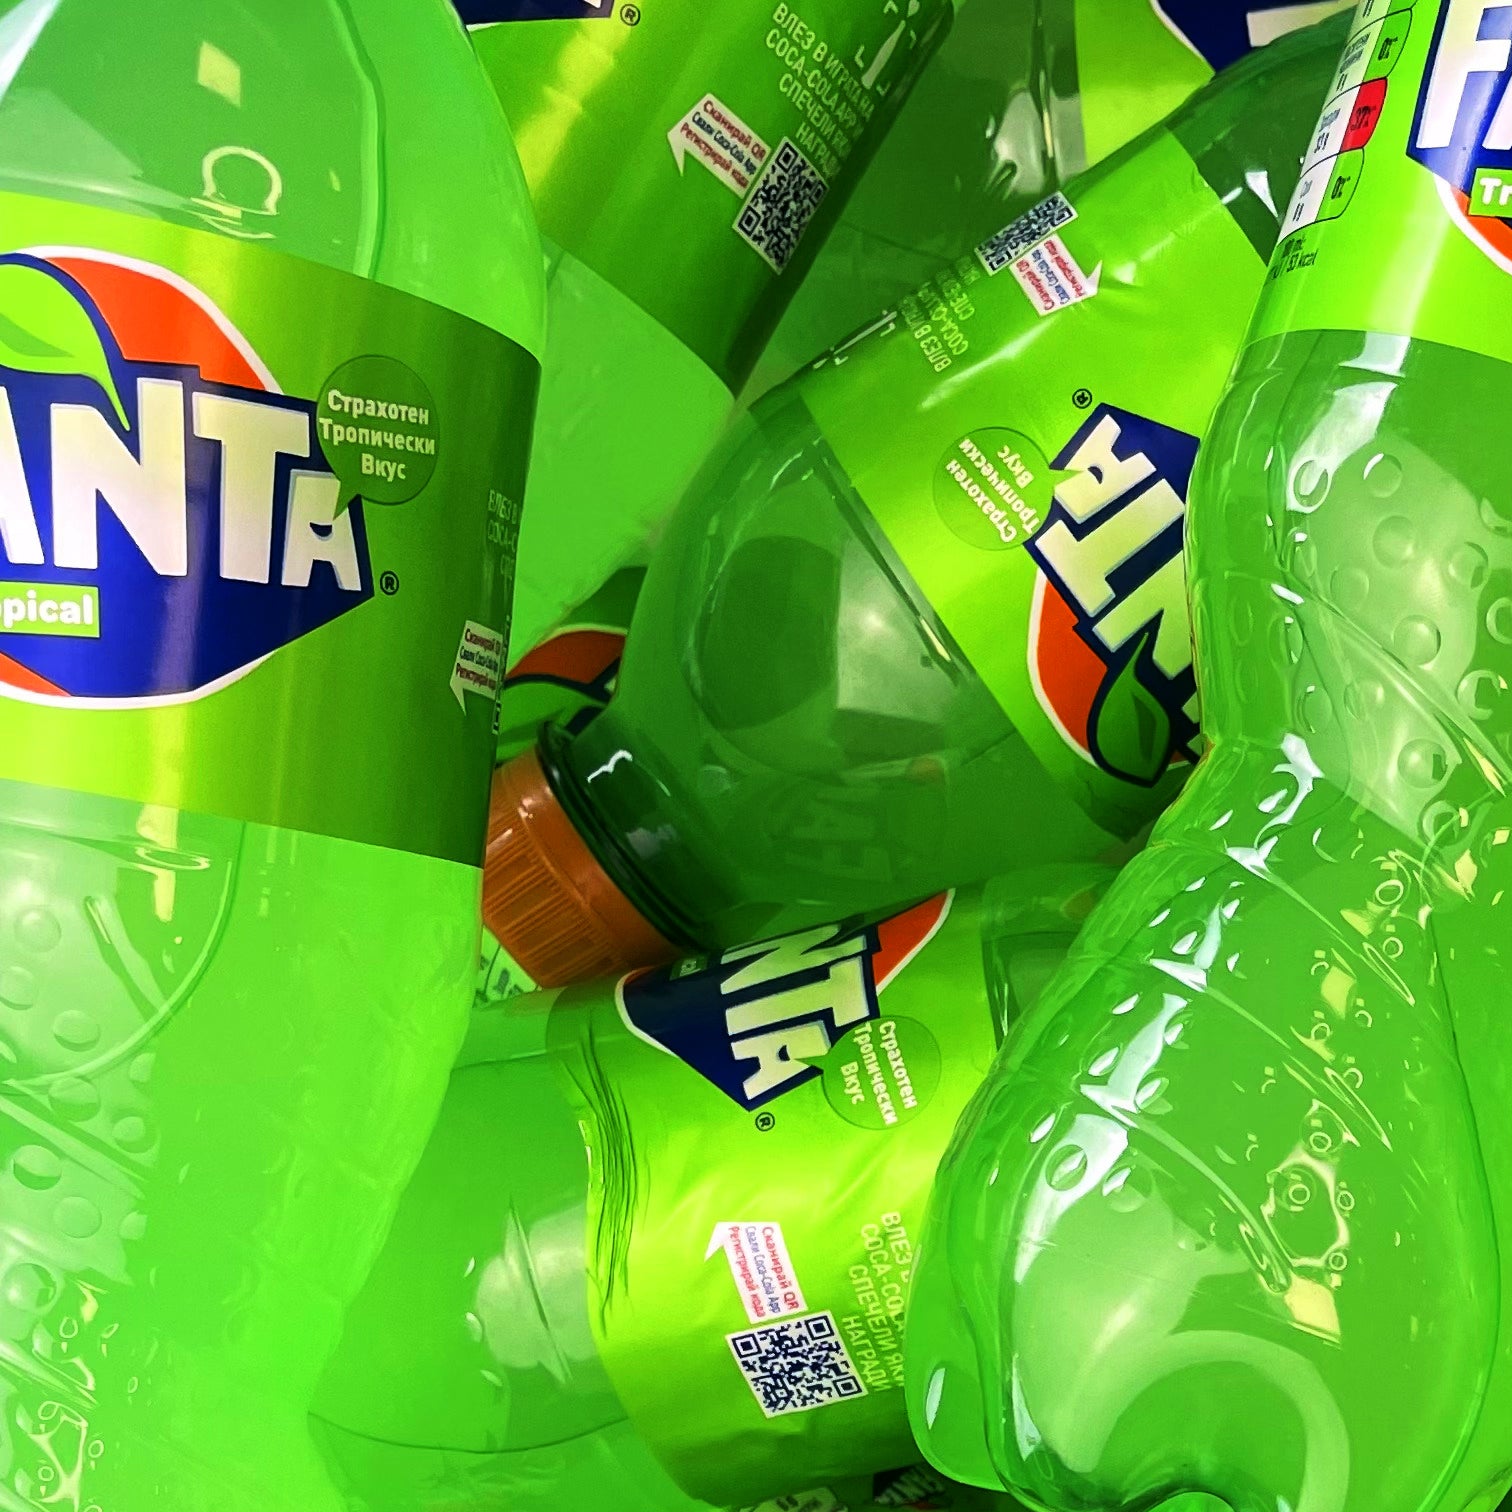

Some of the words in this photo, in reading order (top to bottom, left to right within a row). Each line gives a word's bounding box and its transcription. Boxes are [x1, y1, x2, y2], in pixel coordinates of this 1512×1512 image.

[772, 2, 816, 50] ВЛЕЗ
[812, 42, 828, 62] В
[919, 336, 952, 373] ВЛЕЗ
[318, 416, 436, 456] Тропически
[327, 389, 430, 426] Страхотен
[361, 453, 407, 482] Вкус
[958, 438, 1041, 535] Тропически
[996, 445, 1034, 489] Вкус
[945, 459, 1017, 543] Страхотен
[840, 1061, 866, 1105] Вкус
[853, 1022, 899, 1126] Тропически
[879, 1021, 918, 1109] Страхотен
[728, 1226, 759, 1293] Регистрирай
[762, 1226, 791, 1290] Сканирай
[783, 1291, 800, 1310] QR
[881, 1211, 913, 1265] ВЛЕЗ
[849, 1264, 898, 1351] СПЕЧЕЛИ
[842, 1315, 893, 1392] НАГРАДИ
